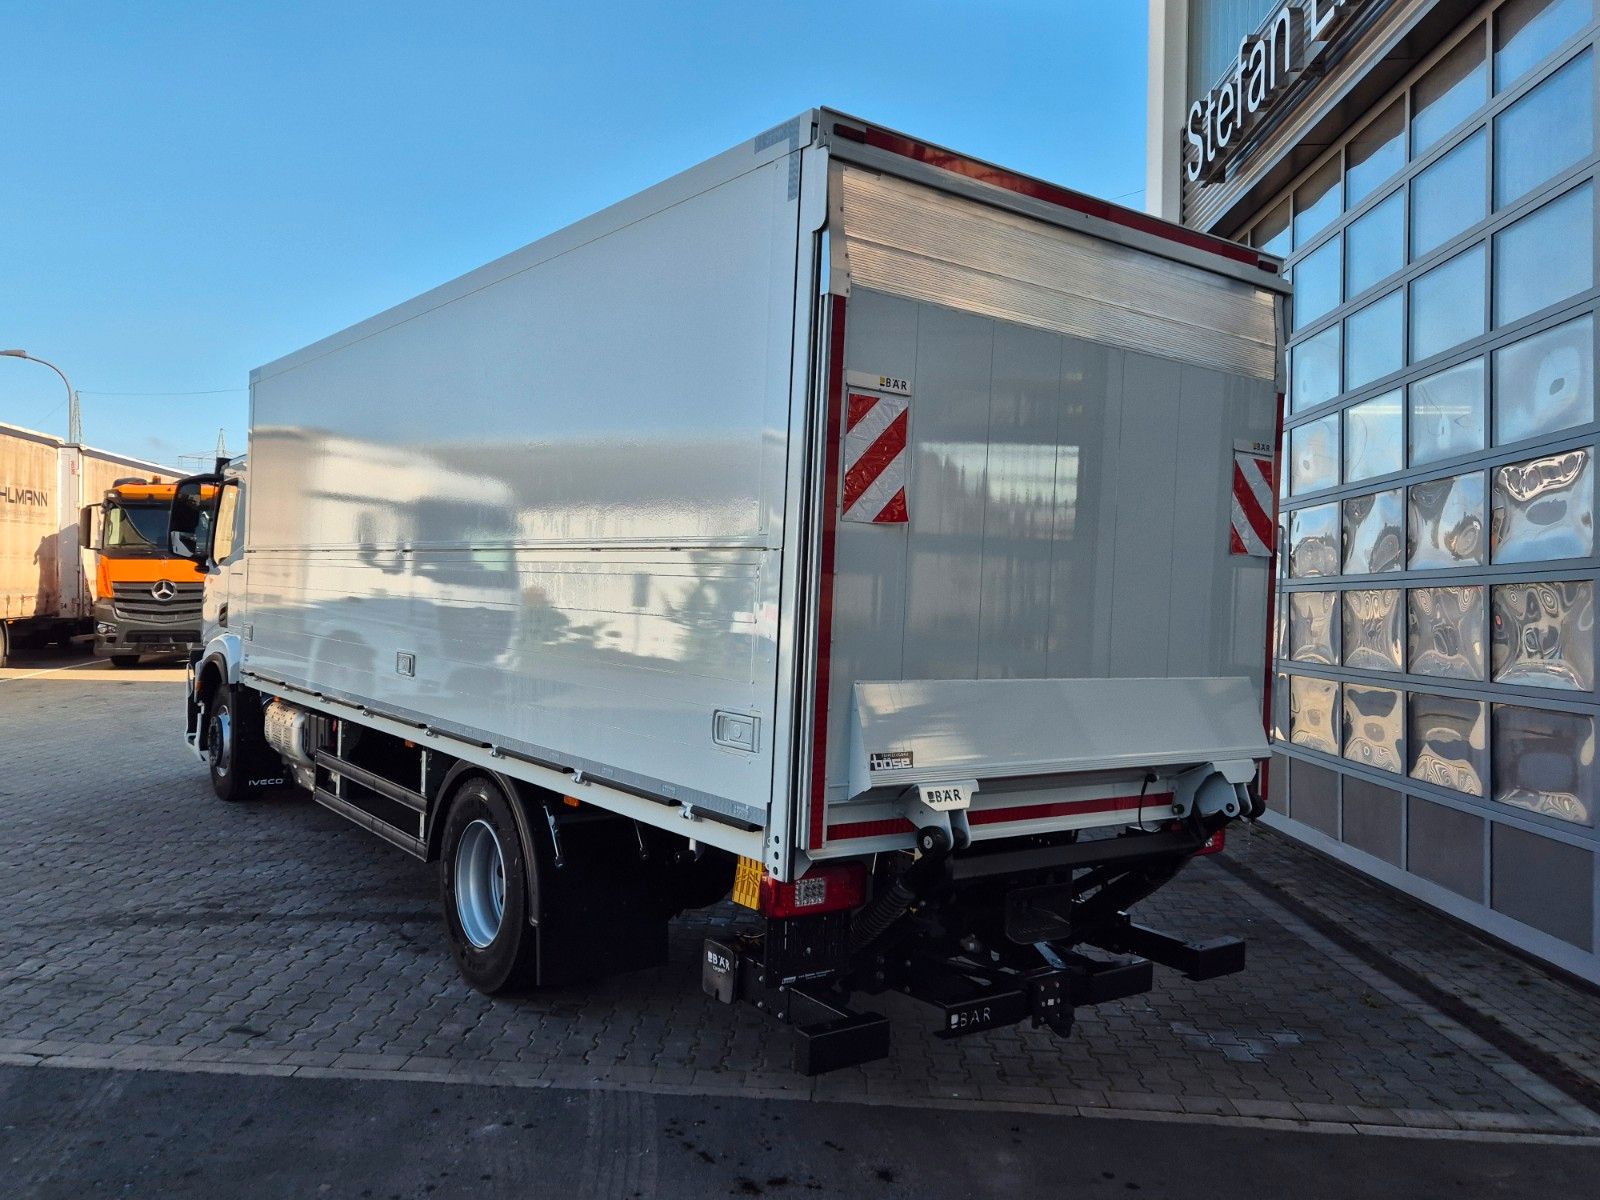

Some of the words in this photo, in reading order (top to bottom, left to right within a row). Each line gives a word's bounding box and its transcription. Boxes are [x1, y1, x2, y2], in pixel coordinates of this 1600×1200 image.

[1187, 7, 1290, 182] Stefan
[885, 377, 908, 391] BÄR
[248, 778, 284, 786] IVECO
[935, 789, 962, 803] BÄR
